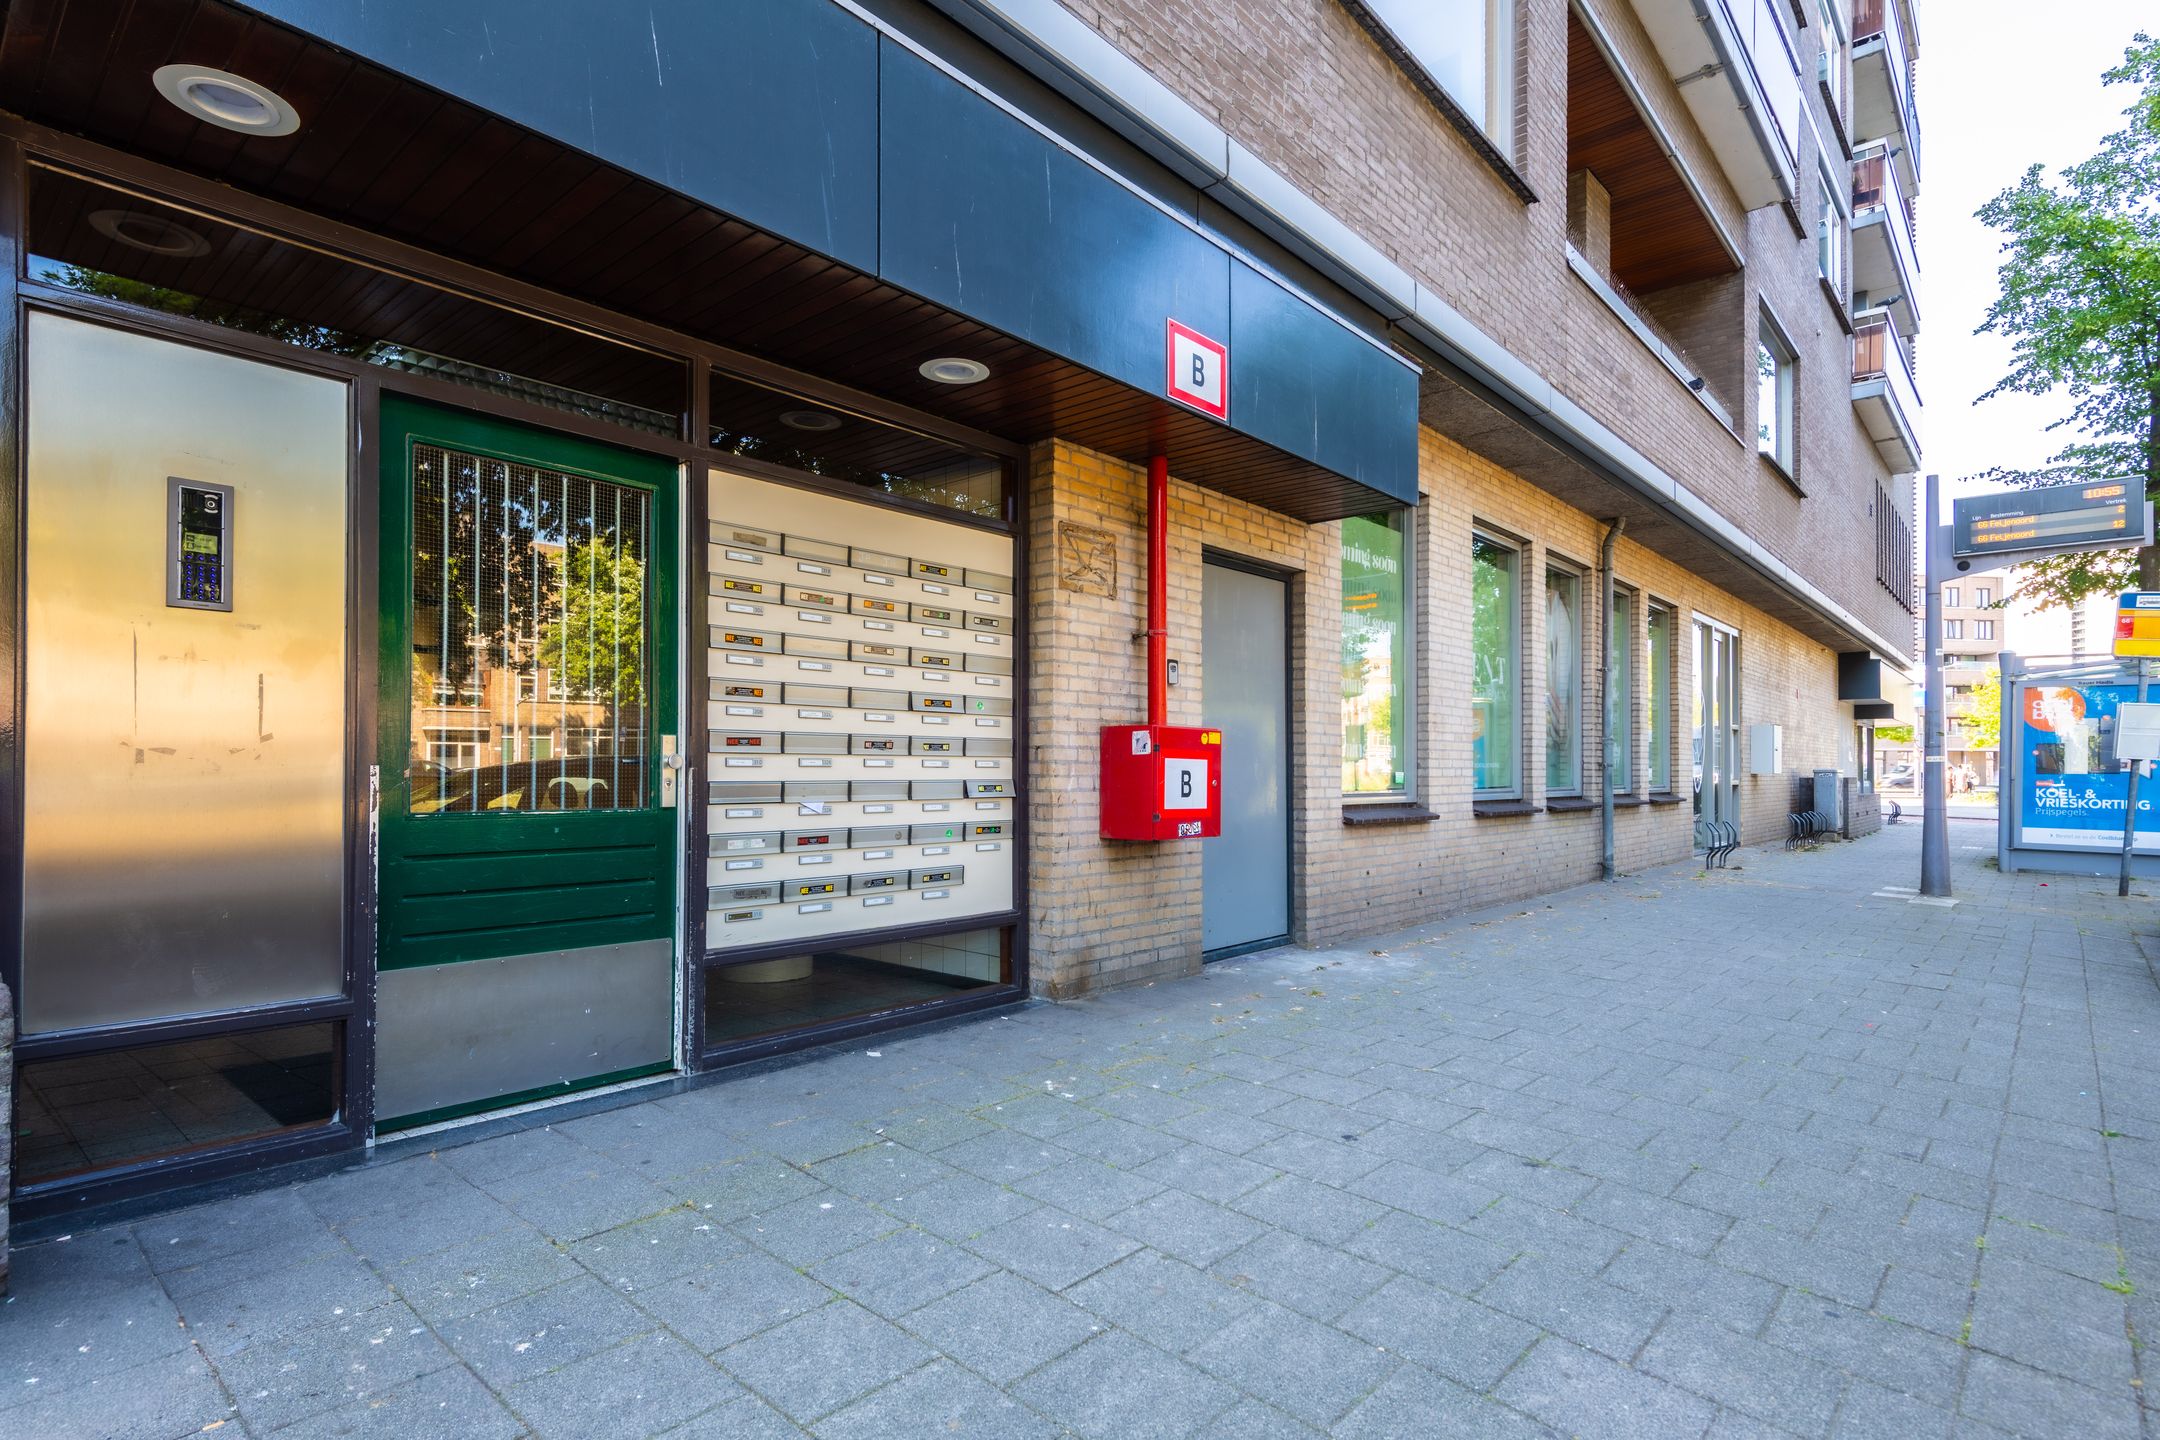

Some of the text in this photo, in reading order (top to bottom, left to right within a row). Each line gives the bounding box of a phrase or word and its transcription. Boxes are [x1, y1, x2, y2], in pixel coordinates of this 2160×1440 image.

[1192, 352, 1205, 388] B
[2087, 485, 2121, 499] 10:55
[2117, 504, 2126, 514] 2
[1341, 542, 1371, 570] ming
[1180, 769, 1192, 798] B
[2035, 788, 2097, 799] KOEL- &
